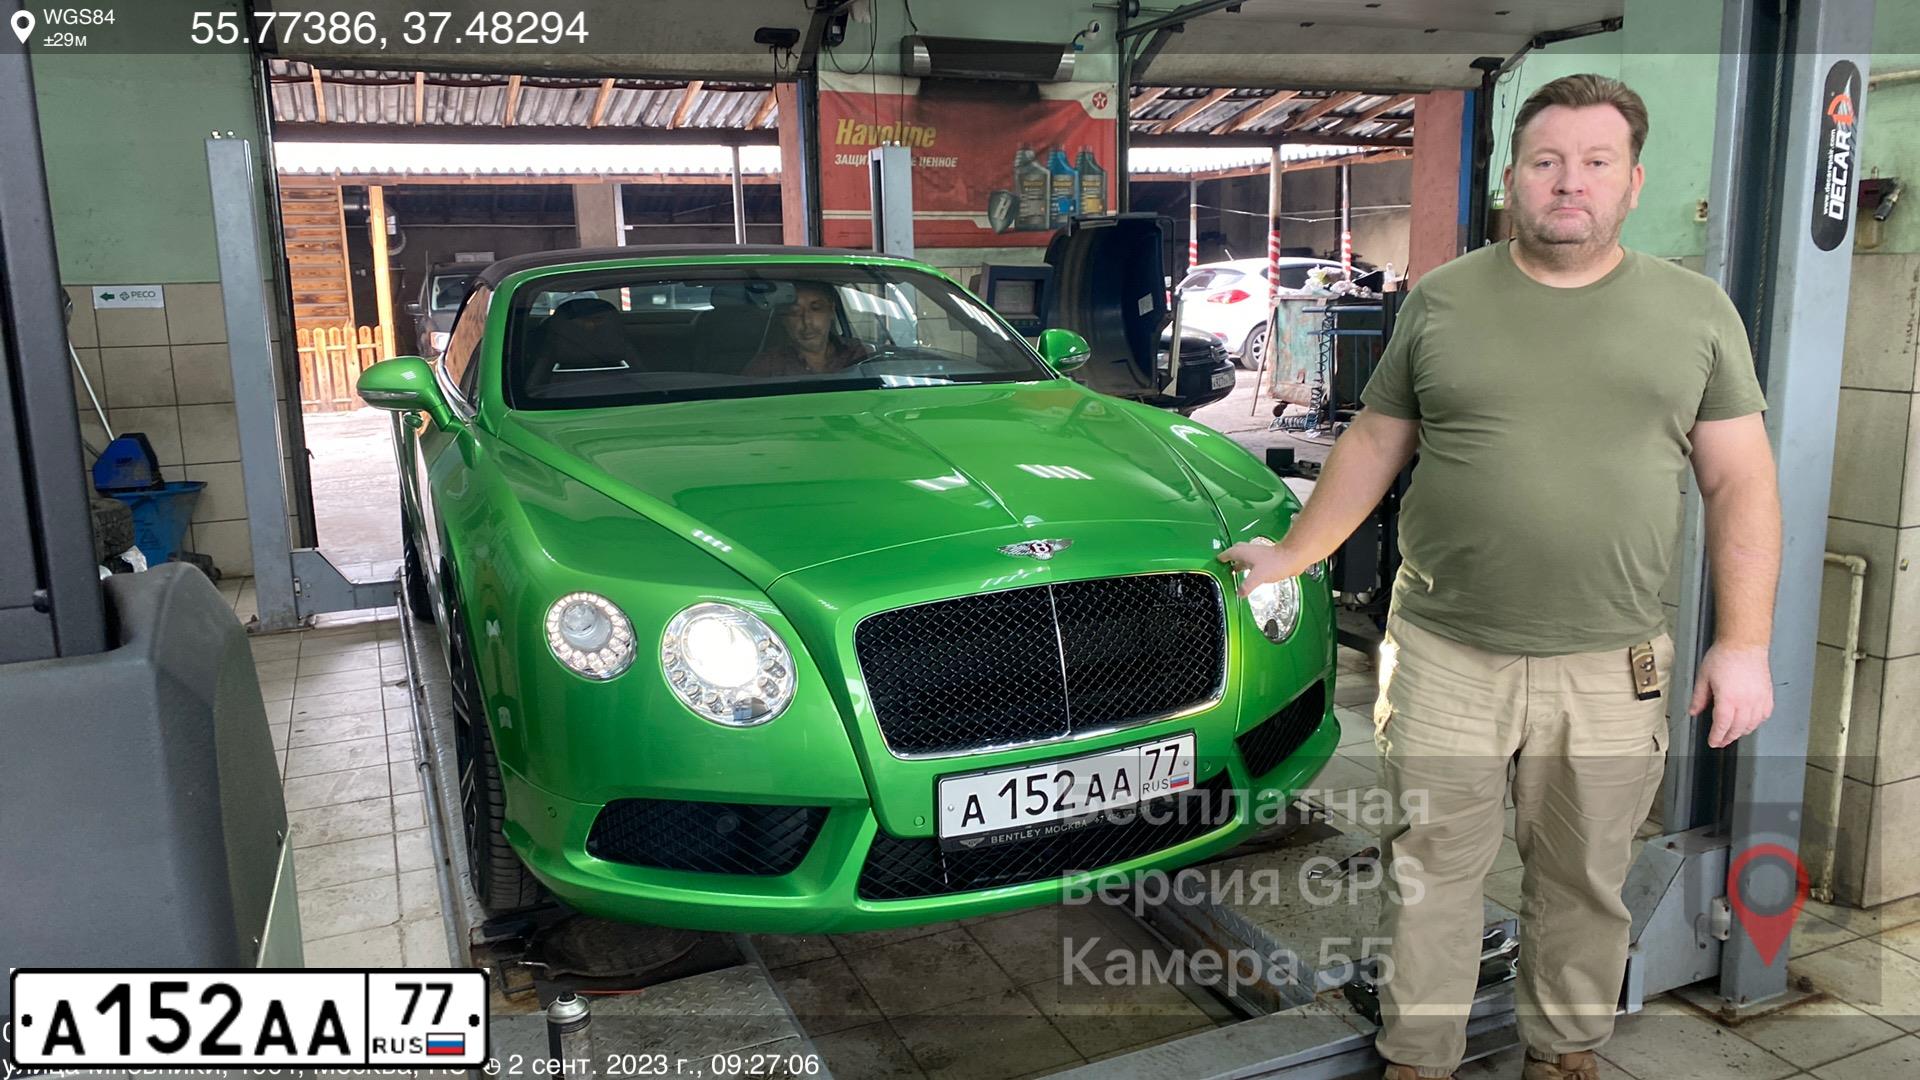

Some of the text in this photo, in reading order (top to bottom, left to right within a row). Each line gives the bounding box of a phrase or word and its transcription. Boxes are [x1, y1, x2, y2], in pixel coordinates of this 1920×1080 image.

[835, 119, 937, 148] Havoline
[919, 156, 958, 168] ЦЕННОЕ
[1828, 129, 1852, 221] DECAR
[1145, 743, 1181, 781] 77
[1142, 778, 1170, 795] RUS
[990, 818, 1089, 845] BENTLEY МОСКВА
